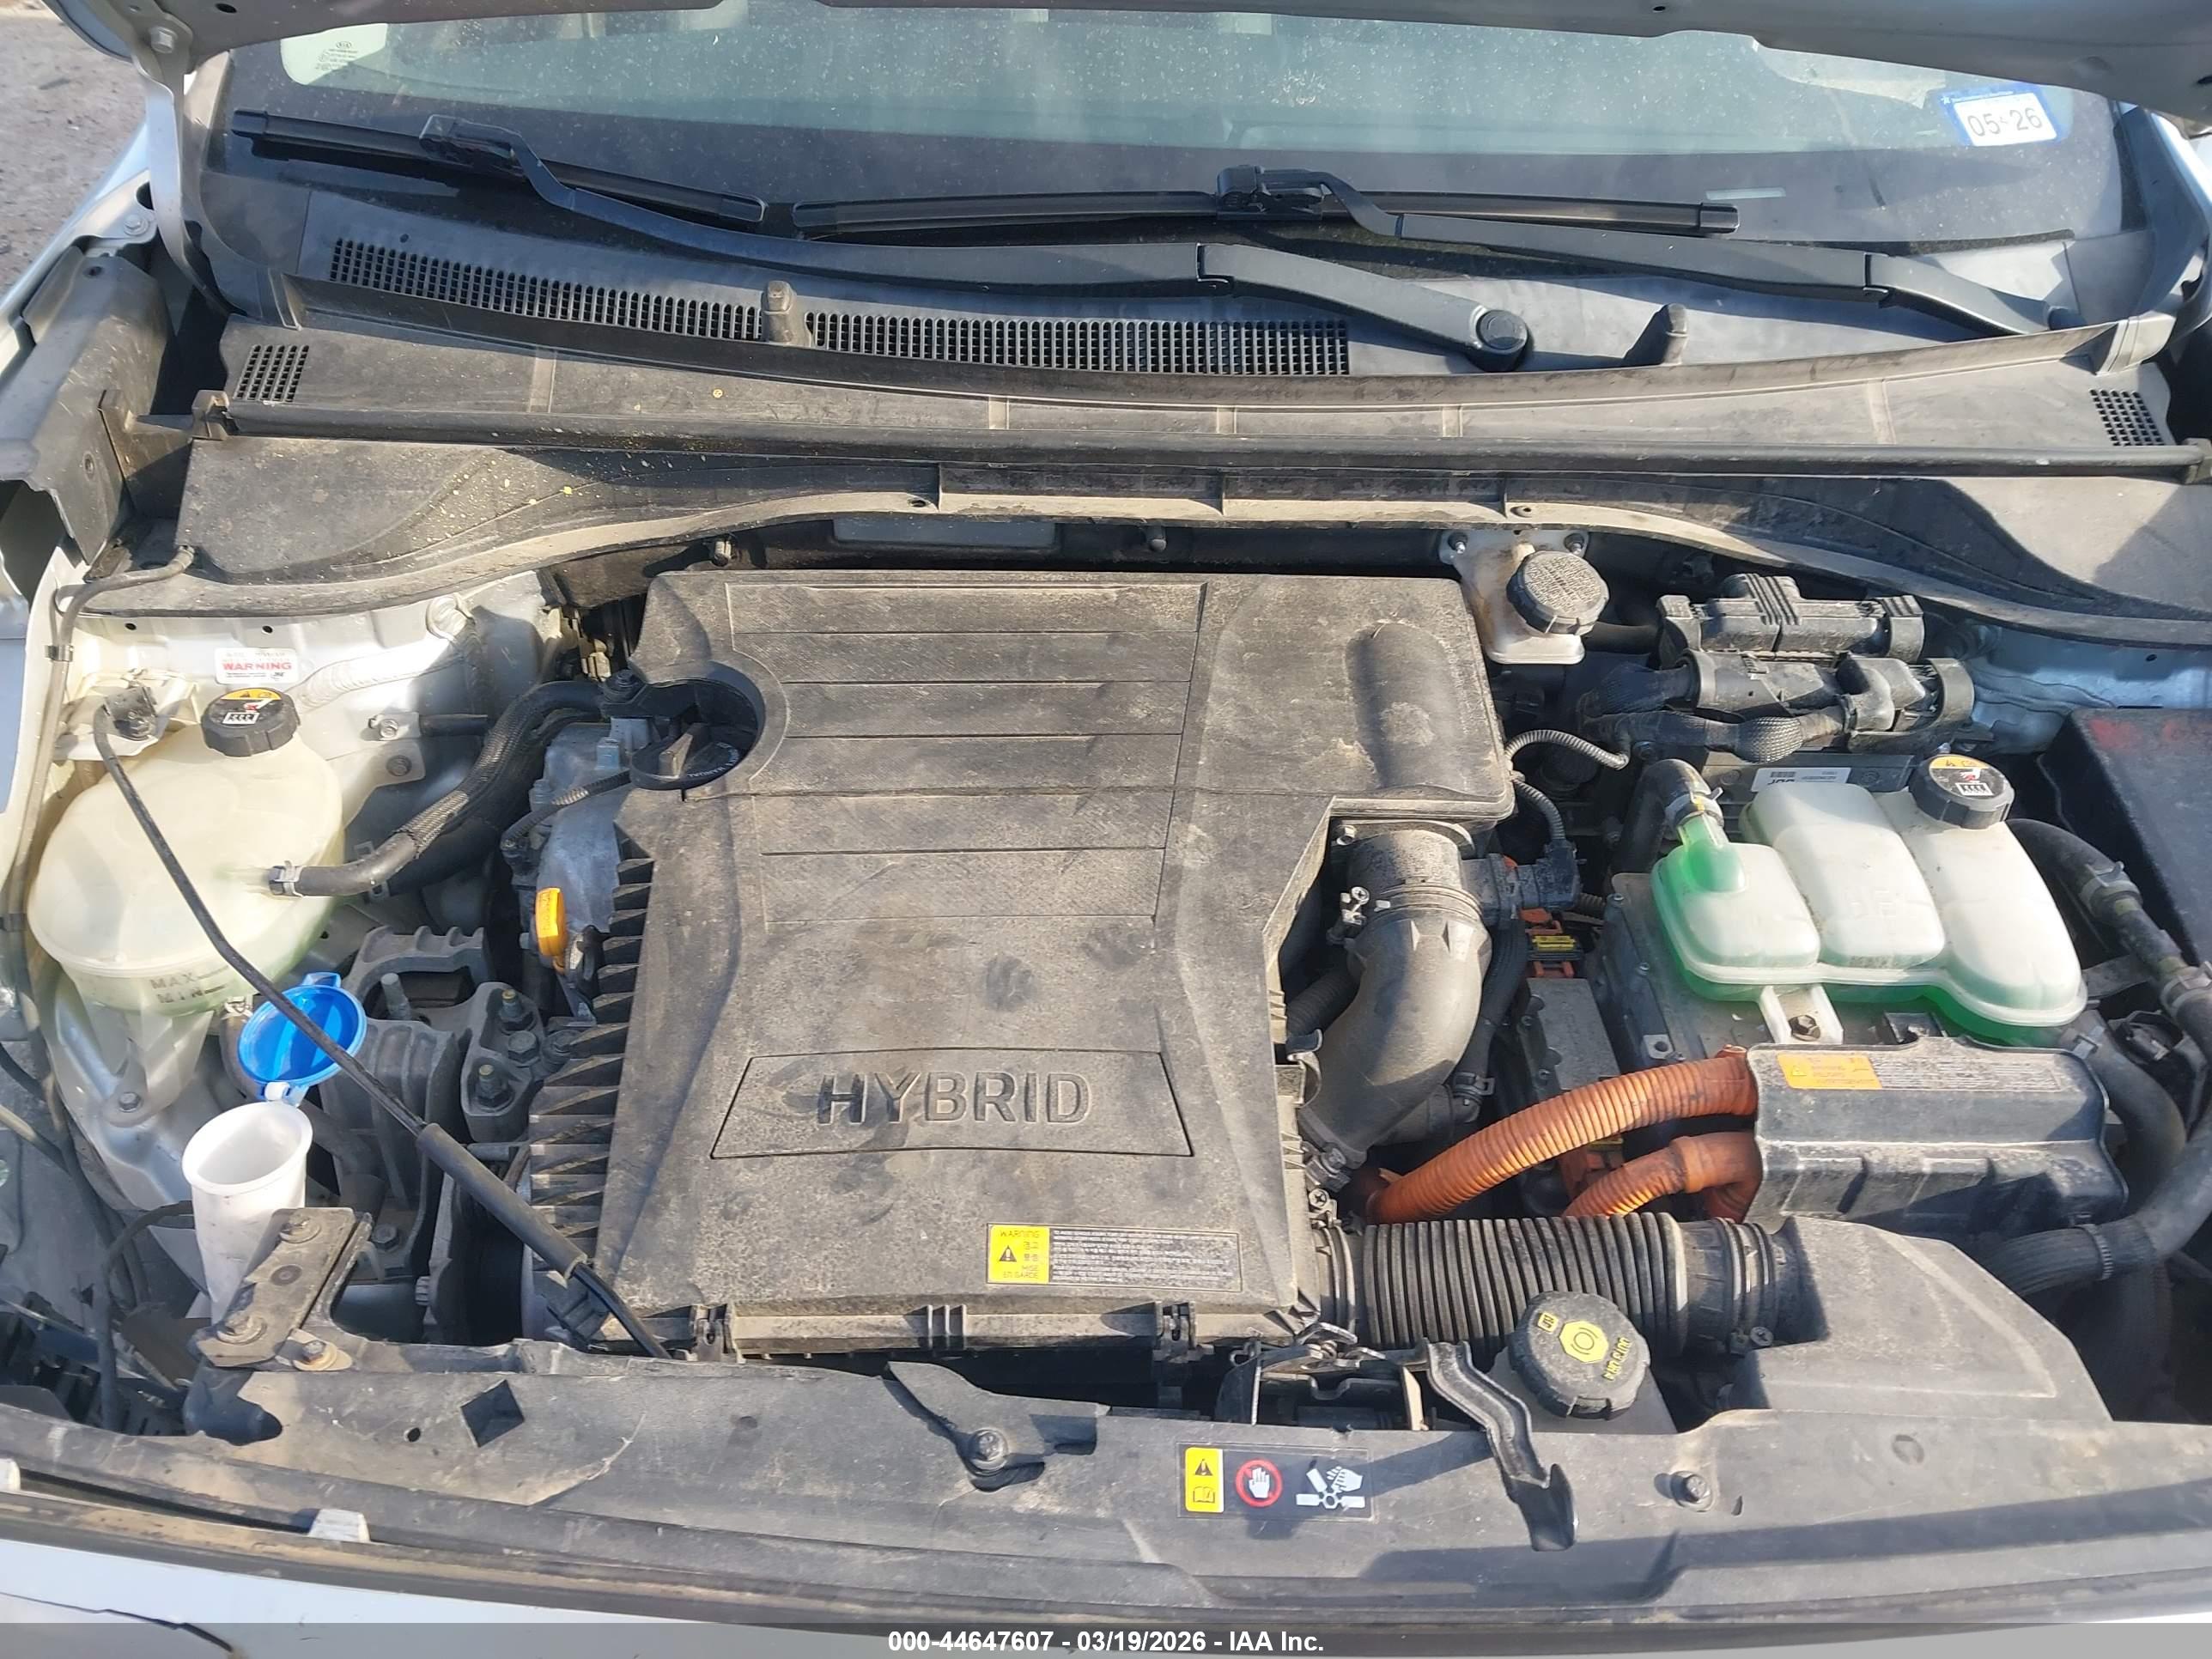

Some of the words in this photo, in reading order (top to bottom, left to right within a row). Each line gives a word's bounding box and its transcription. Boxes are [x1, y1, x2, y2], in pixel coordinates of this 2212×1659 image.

[1967, 114, 2001, 137] 05
[2009, 107, 2043, 131] 26
[222, 661, 292, 671] WARNING
[149, 971, 196, 989] MAX
[817, 1071, 1094, 1124] HYBRID
